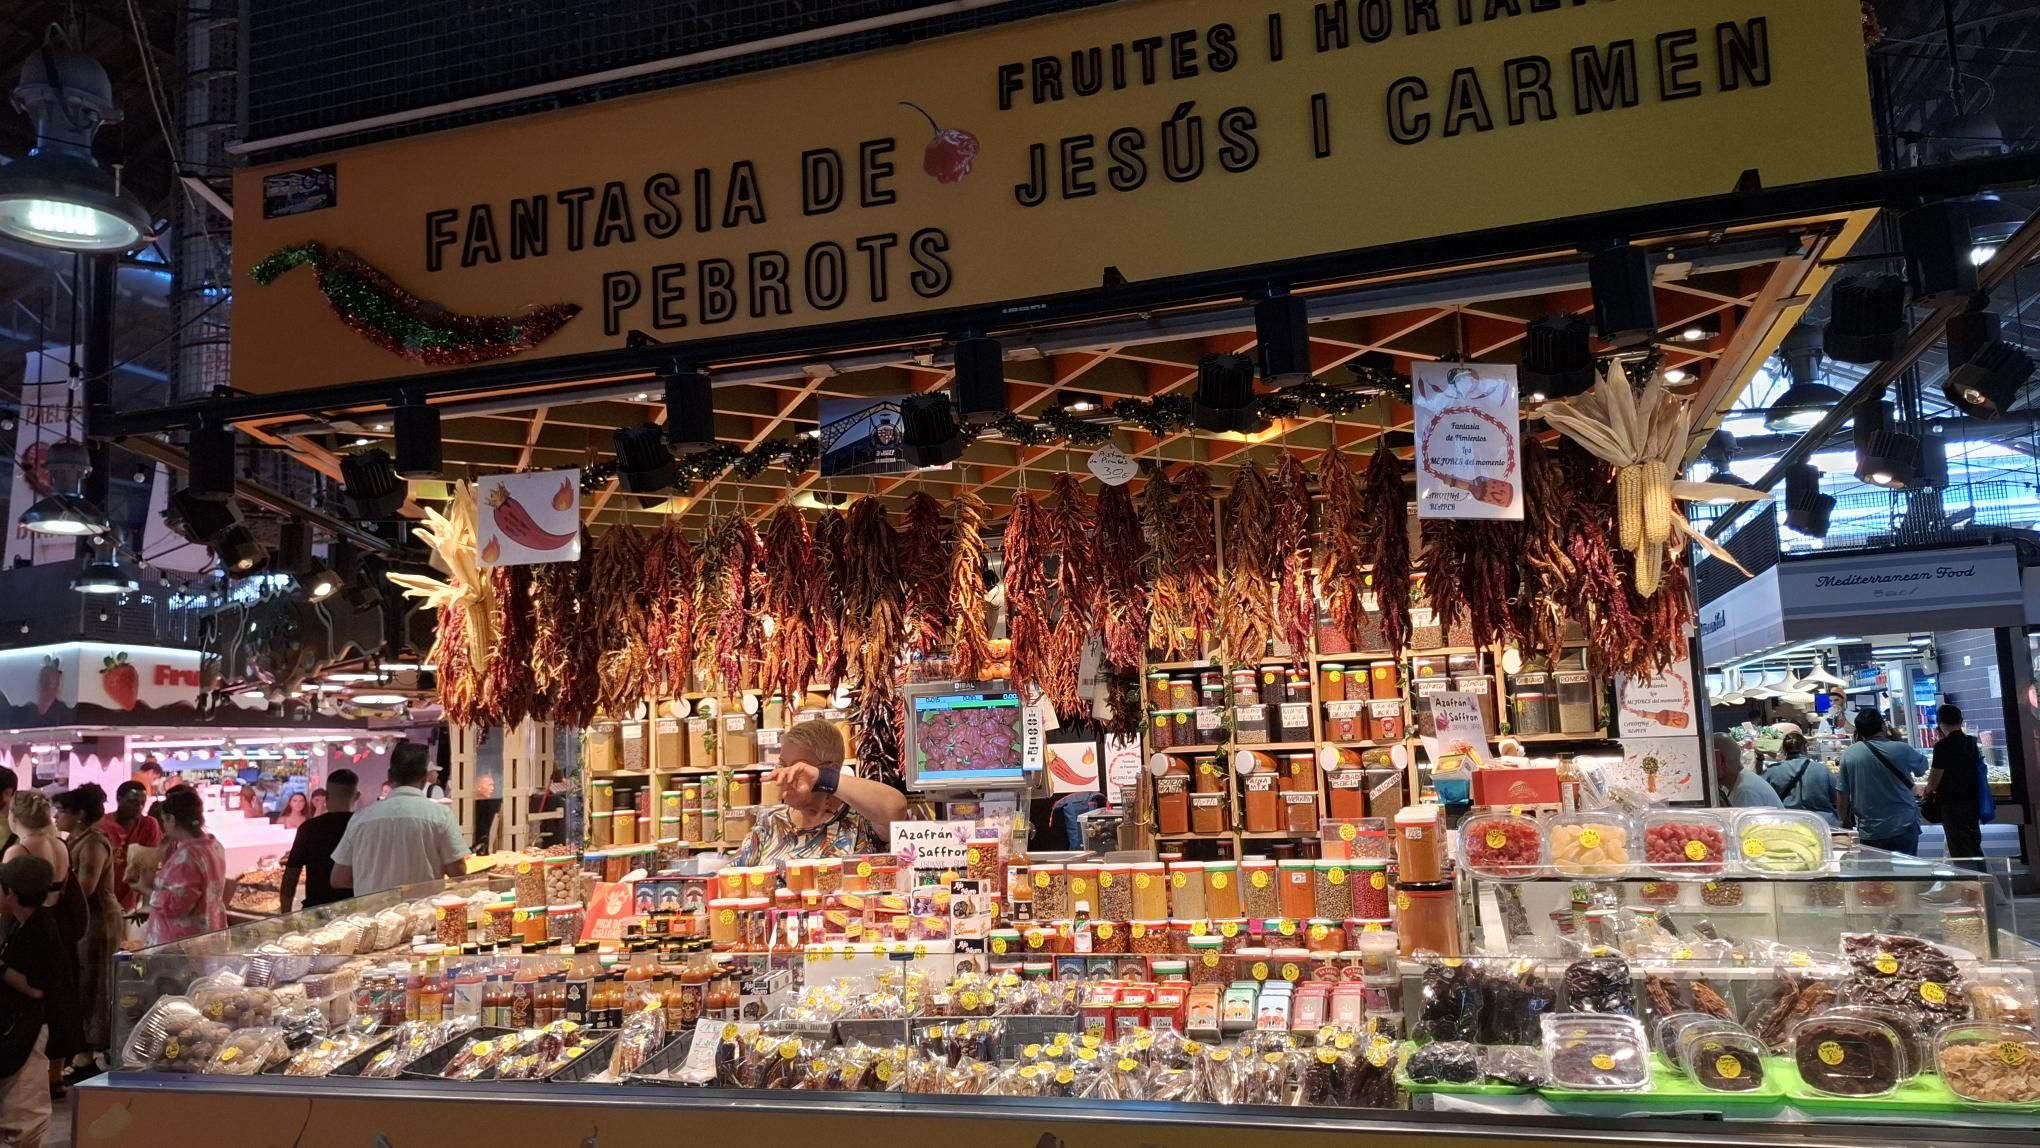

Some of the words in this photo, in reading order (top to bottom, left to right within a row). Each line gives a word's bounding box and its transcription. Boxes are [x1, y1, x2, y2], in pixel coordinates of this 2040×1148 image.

[998, 23, 1239, 110] FRUITES
[1268, 12, 1283, 61] I
[1015, 101, 1260, 208] JESÚS
[1311, 93, 1331, 158] I
[1387, 17, 1772, 146] CARMEN
[426, 160, 766, 271] FANTASIA
[802, 137, 896, 216] DE
[603, 228, 951, 336] PEBROTS
[1816, 571, 1931, 588] Mediterranean
[1936, 565, 1975, 579] Food
[154, 665, 200, 687] Fru
[1449, 712, 1478, 722] Saffron
[899, 827, 952, 840] Azafrán
